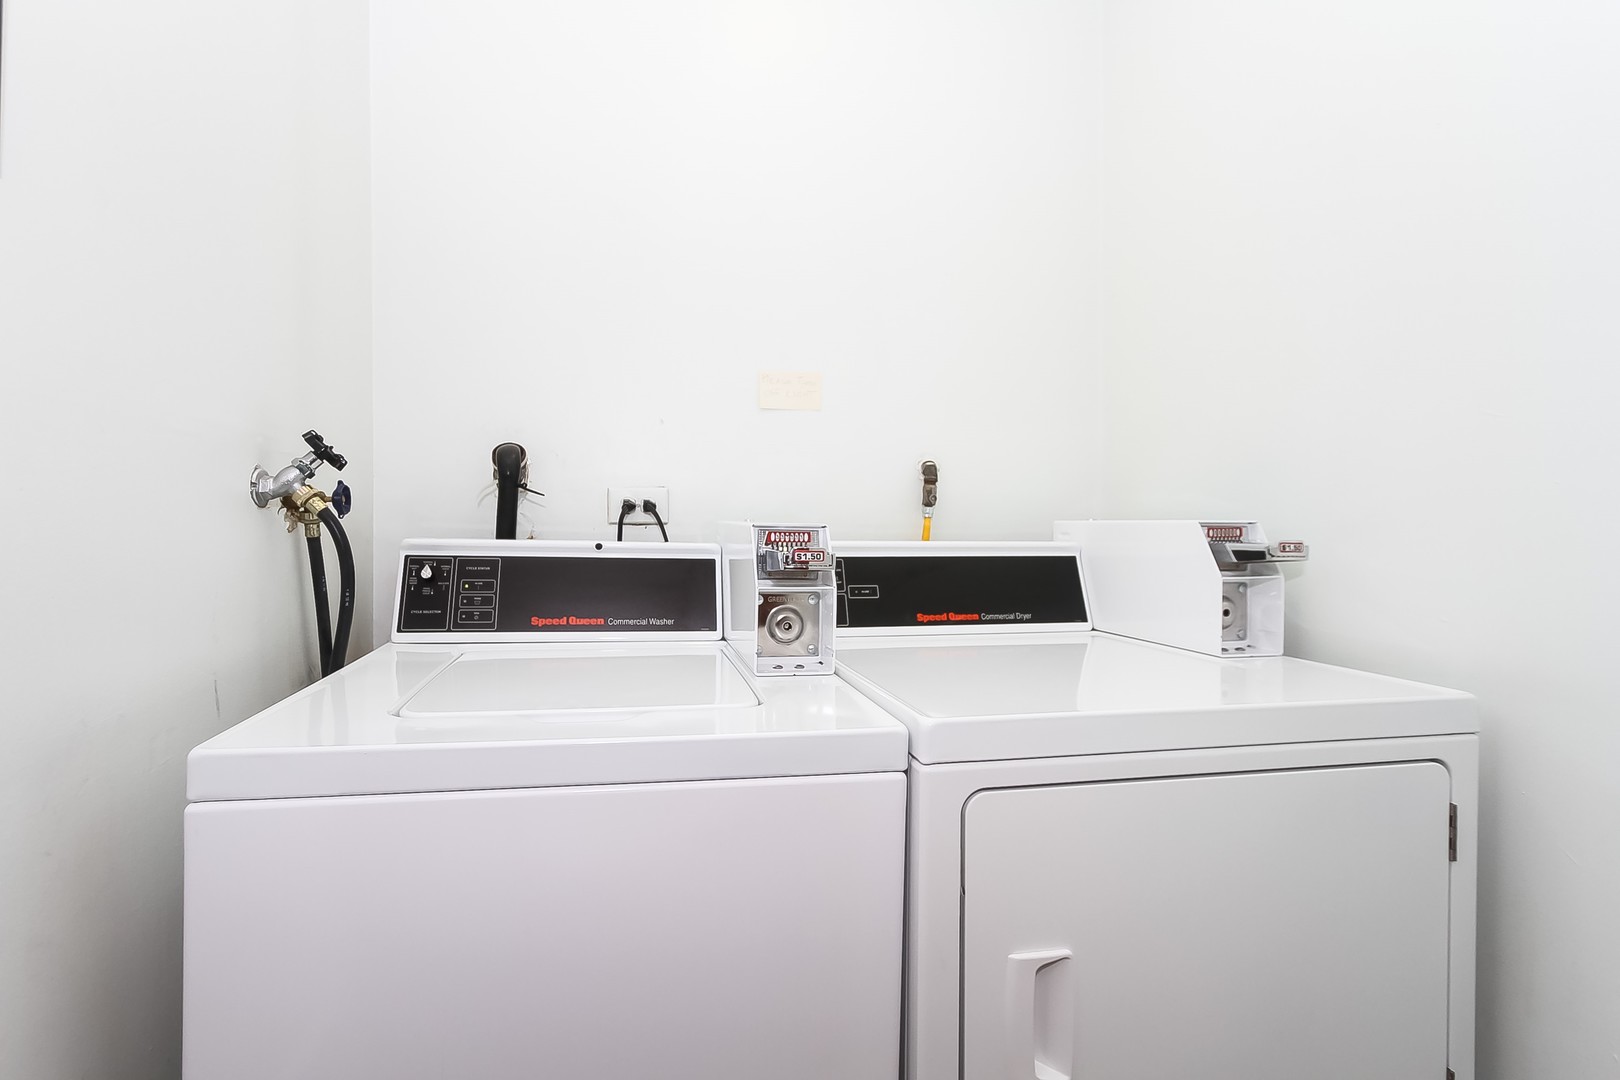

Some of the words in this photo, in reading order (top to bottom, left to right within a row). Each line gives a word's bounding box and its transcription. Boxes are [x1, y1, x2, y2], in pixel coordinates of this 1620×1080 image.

[796, 553, 822, 561] $1.50
[530, 616, 567, 627] Speed
[569, 615, 605, 625] Queen
[607, 617, 648, 626] Commercial
[649, 617, 675, 625] Washer
[917, 612, 947, 623] Speed
[949, 612, 979, 621] Queen
[981, 612, 1015, 621] Commercial
[1016, 612, 1032, 621] Dryer
